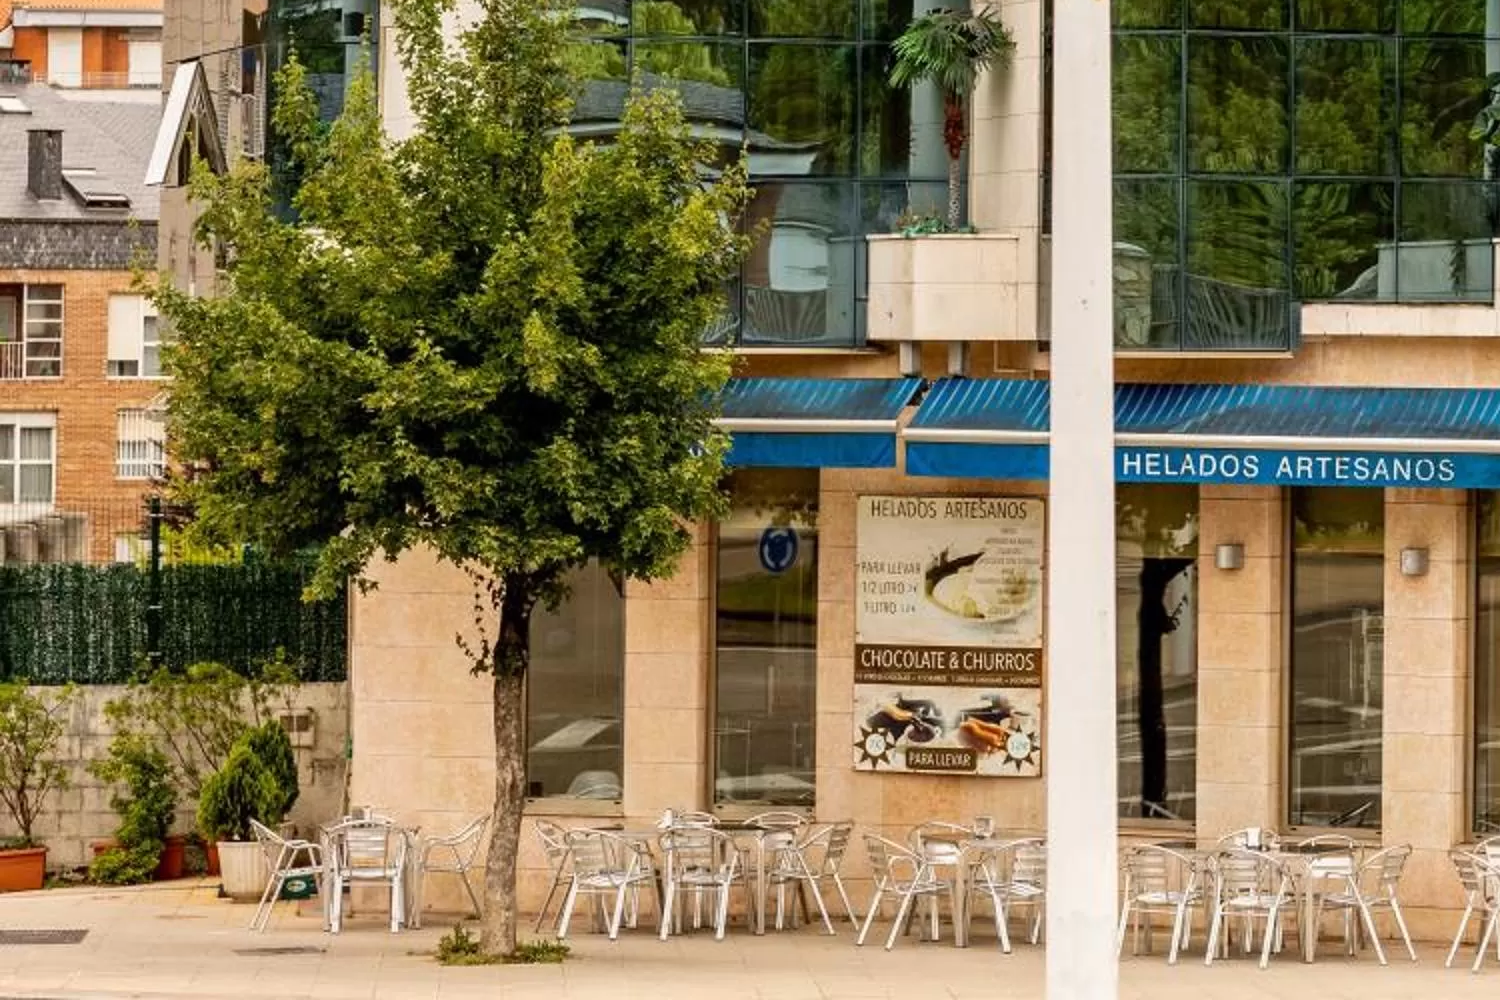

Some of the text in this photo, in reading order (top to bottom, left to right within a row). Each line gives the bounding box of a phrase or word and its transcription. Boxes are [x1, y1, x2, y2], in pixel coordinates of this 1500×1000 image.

[1122, 452, 1456, 482] HELADOS ARTESANOS
[871, 500, 1027, 519] HELADOS ARTESANOS
[861, 649, 1035, 671] CHOCOLATE & CHURROS
[908, 751, 971, 767] PARA LLEVAR
